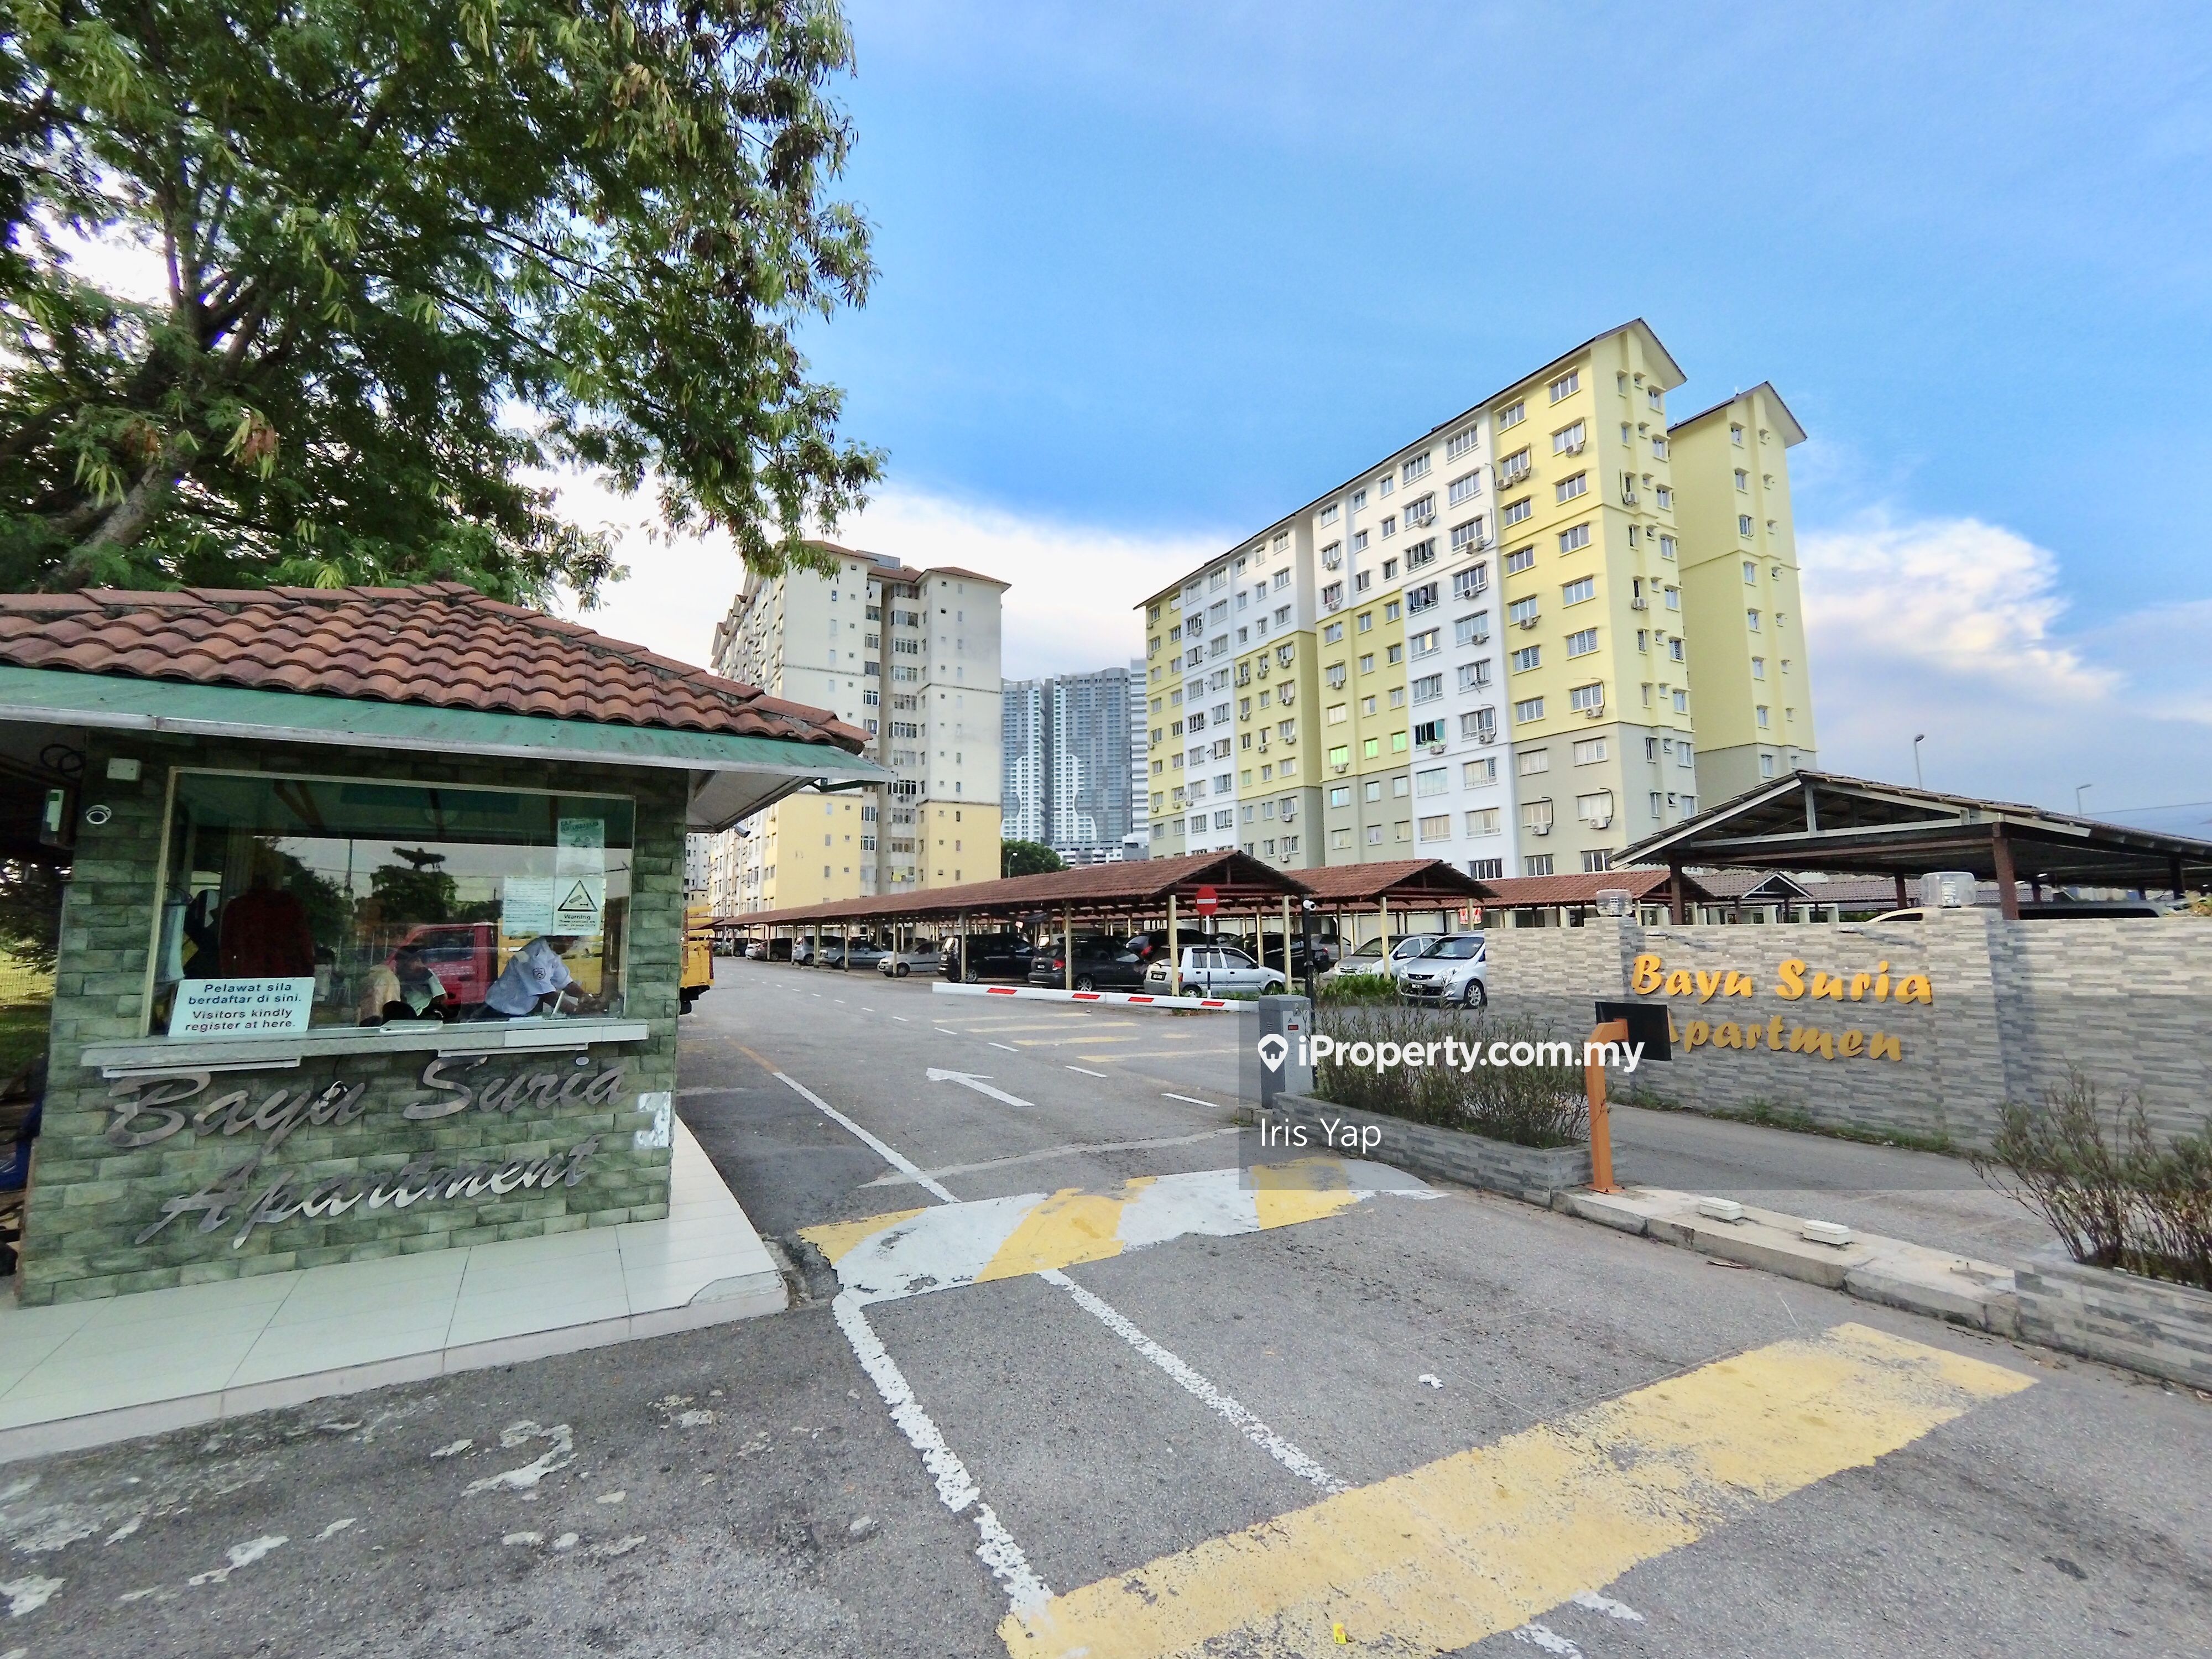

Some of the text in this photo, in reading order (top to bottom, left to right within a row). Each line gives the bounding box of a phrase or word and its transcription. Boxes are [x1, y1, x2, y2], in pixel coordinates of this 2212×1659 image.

[204, 983, 291, 993] Pelawat sila
[1631, 954, 1933, 1004] Bayu Suria
[189, 994, 301, 1005] berdaftar di sini.
[193, 1008, 293, 1019] Visitors kindly
[185, 1021, 240, 1032] register
[263, 1020, 296, 1028] here.
[1667, 1009, 1902, 1061] partmen
[108, 1056, 634, 1155] Bayu Suria
[134, 1134, 603, 1249] Apartment
